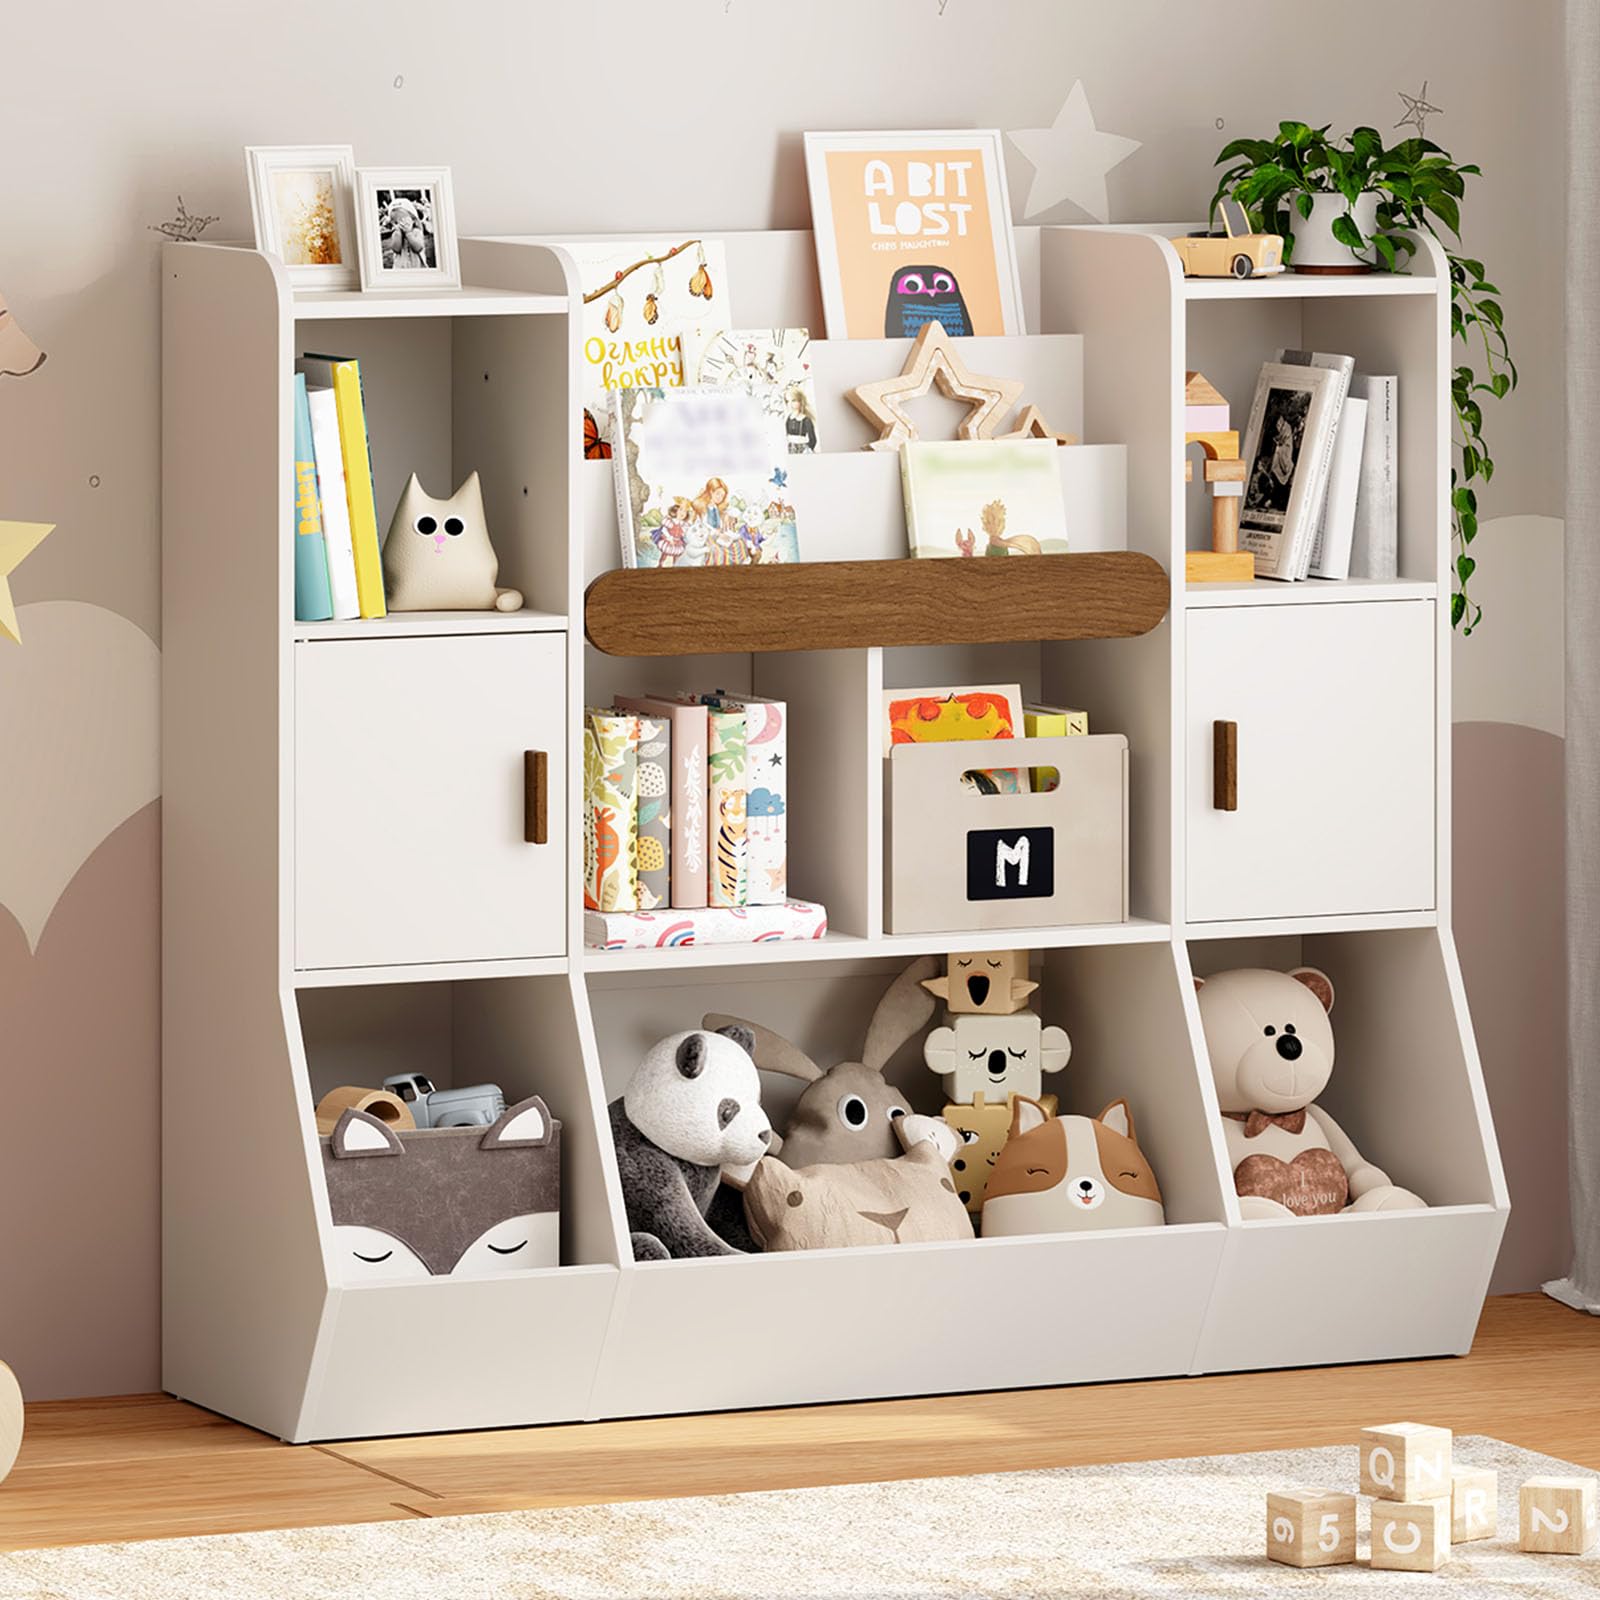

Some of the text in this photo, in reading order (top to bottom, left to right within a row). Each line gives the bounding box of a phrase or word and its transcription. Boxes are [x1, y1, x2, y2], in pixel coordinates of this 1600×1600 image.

[864, 160, 972, 196] A BIT
[867, 201, 972, 236] LOST
[996, 836, 1030, 887] M
[1282, 1192, 1337, 1209] love you
[1369, 1447, 1395, 1489] Q
[1464, 1489, 1489, 1528] R
[1318, 1514, 1341, 1552] 5
